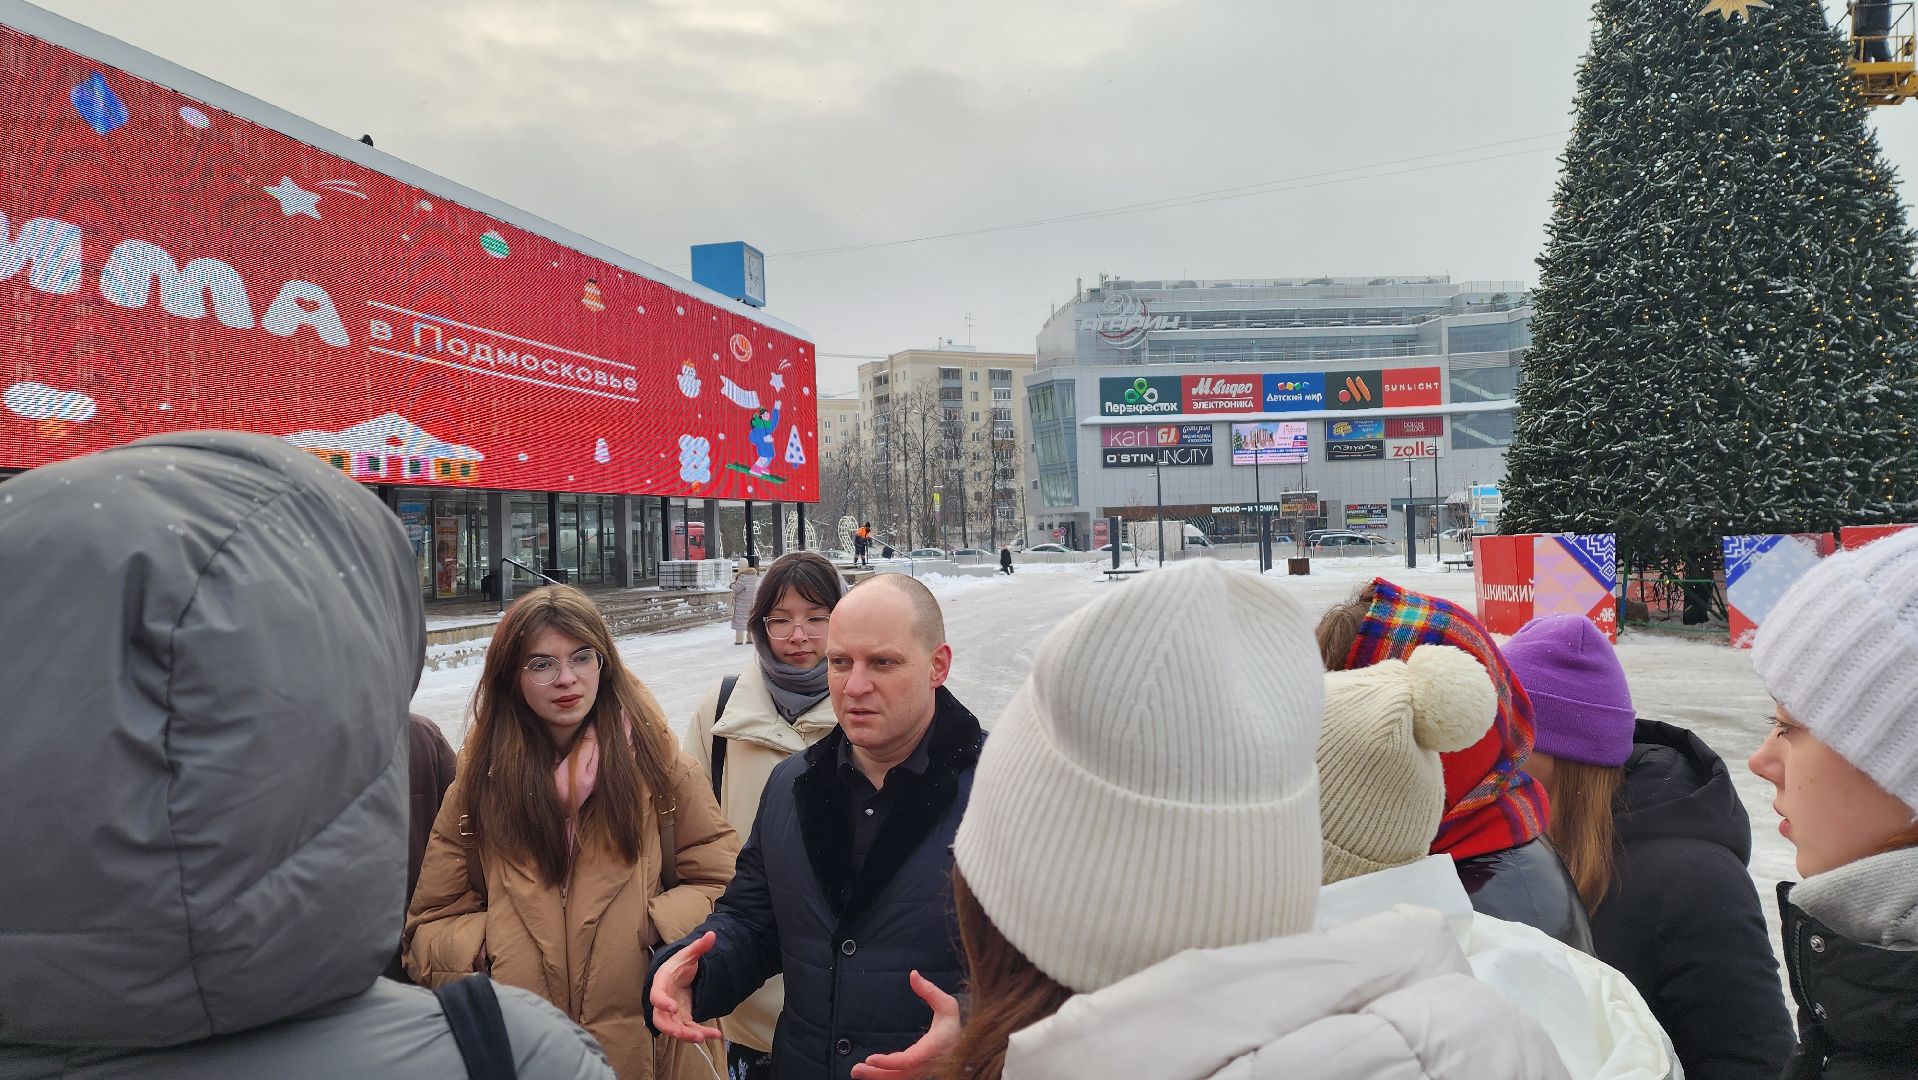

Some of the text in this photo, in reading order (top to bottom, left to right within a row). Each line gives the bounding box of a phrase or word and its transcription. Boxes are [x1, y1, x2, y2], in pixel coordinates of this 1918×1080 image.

[370, 319, 638, 392] в Подмосковье
[1384, 382, 1439, 392] SUNLIGHT
[1266, 392, 1323, 403] Детский мир
[1192, 399, 1254, 410] ЭЛЕКТРОНИКА
[1110, 425, 1149, 447] kari
[1212, 505, 1240, 514] ВКУСНО
